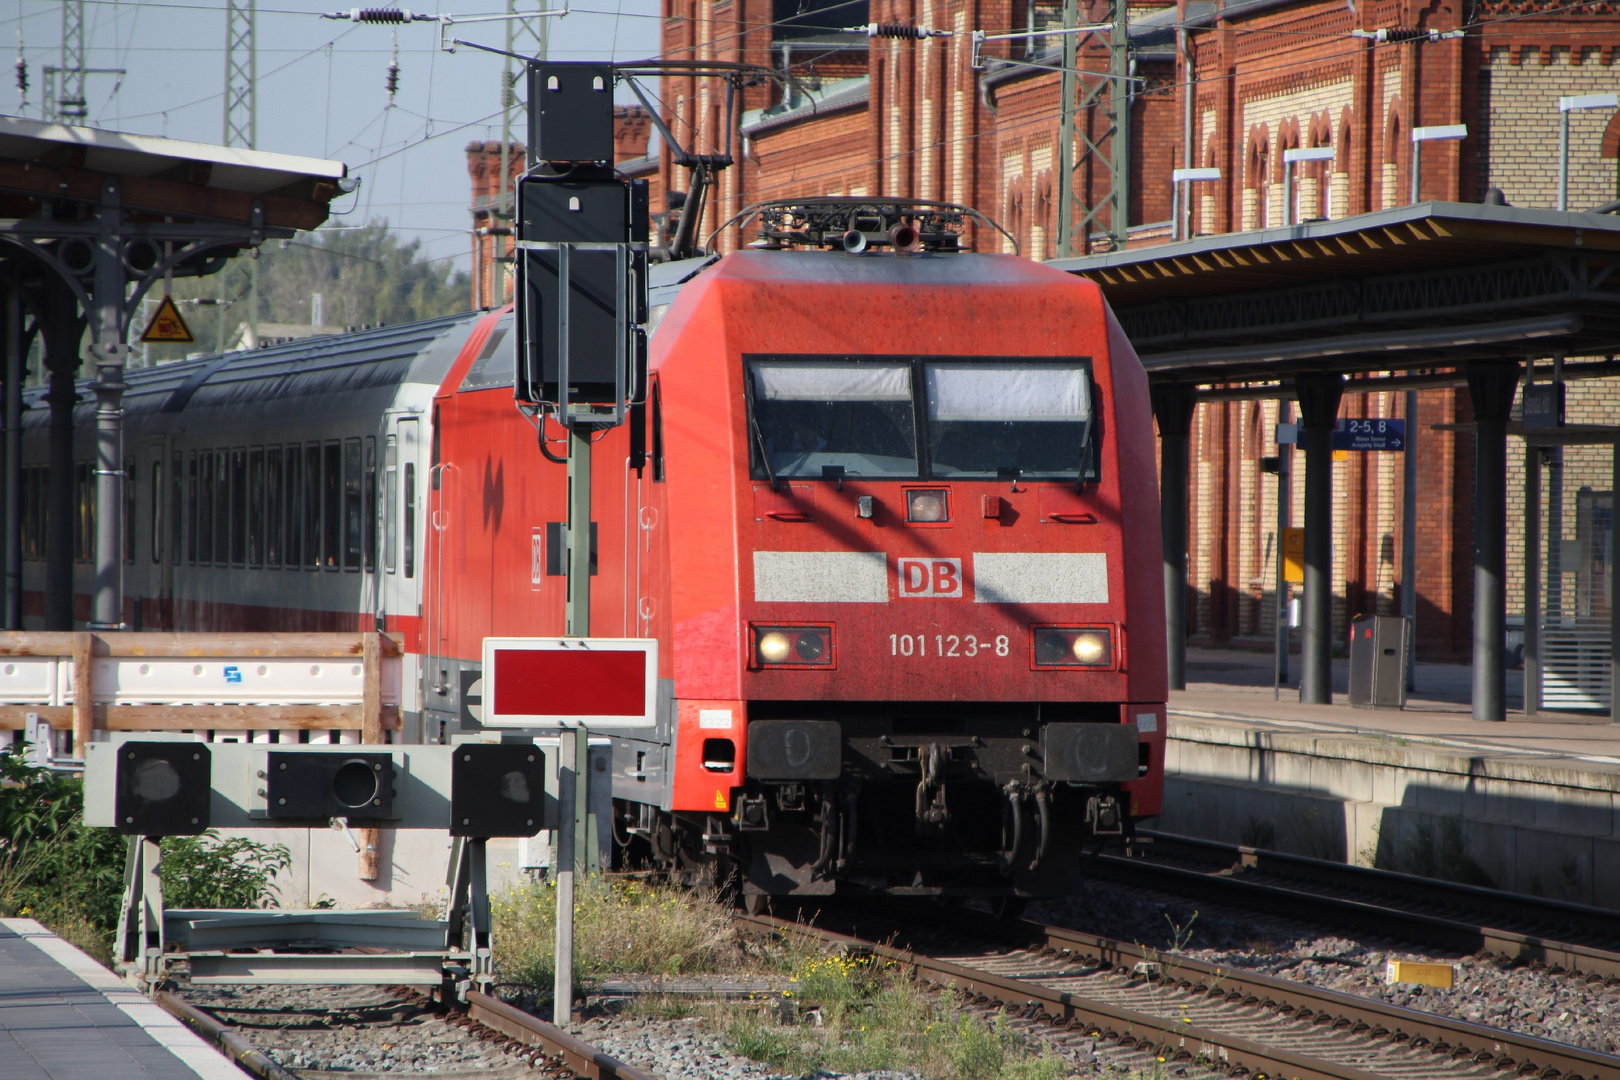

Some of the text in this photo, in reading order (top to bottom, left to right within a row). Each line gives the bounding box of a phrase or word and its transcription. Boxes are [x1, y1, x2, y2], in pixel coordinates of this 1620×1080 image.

[1350, 420, 1387, 434] 2-5, 8
[902, 560, 959, 594] DB
[889, 633, 1010, 657] 101 123-8
